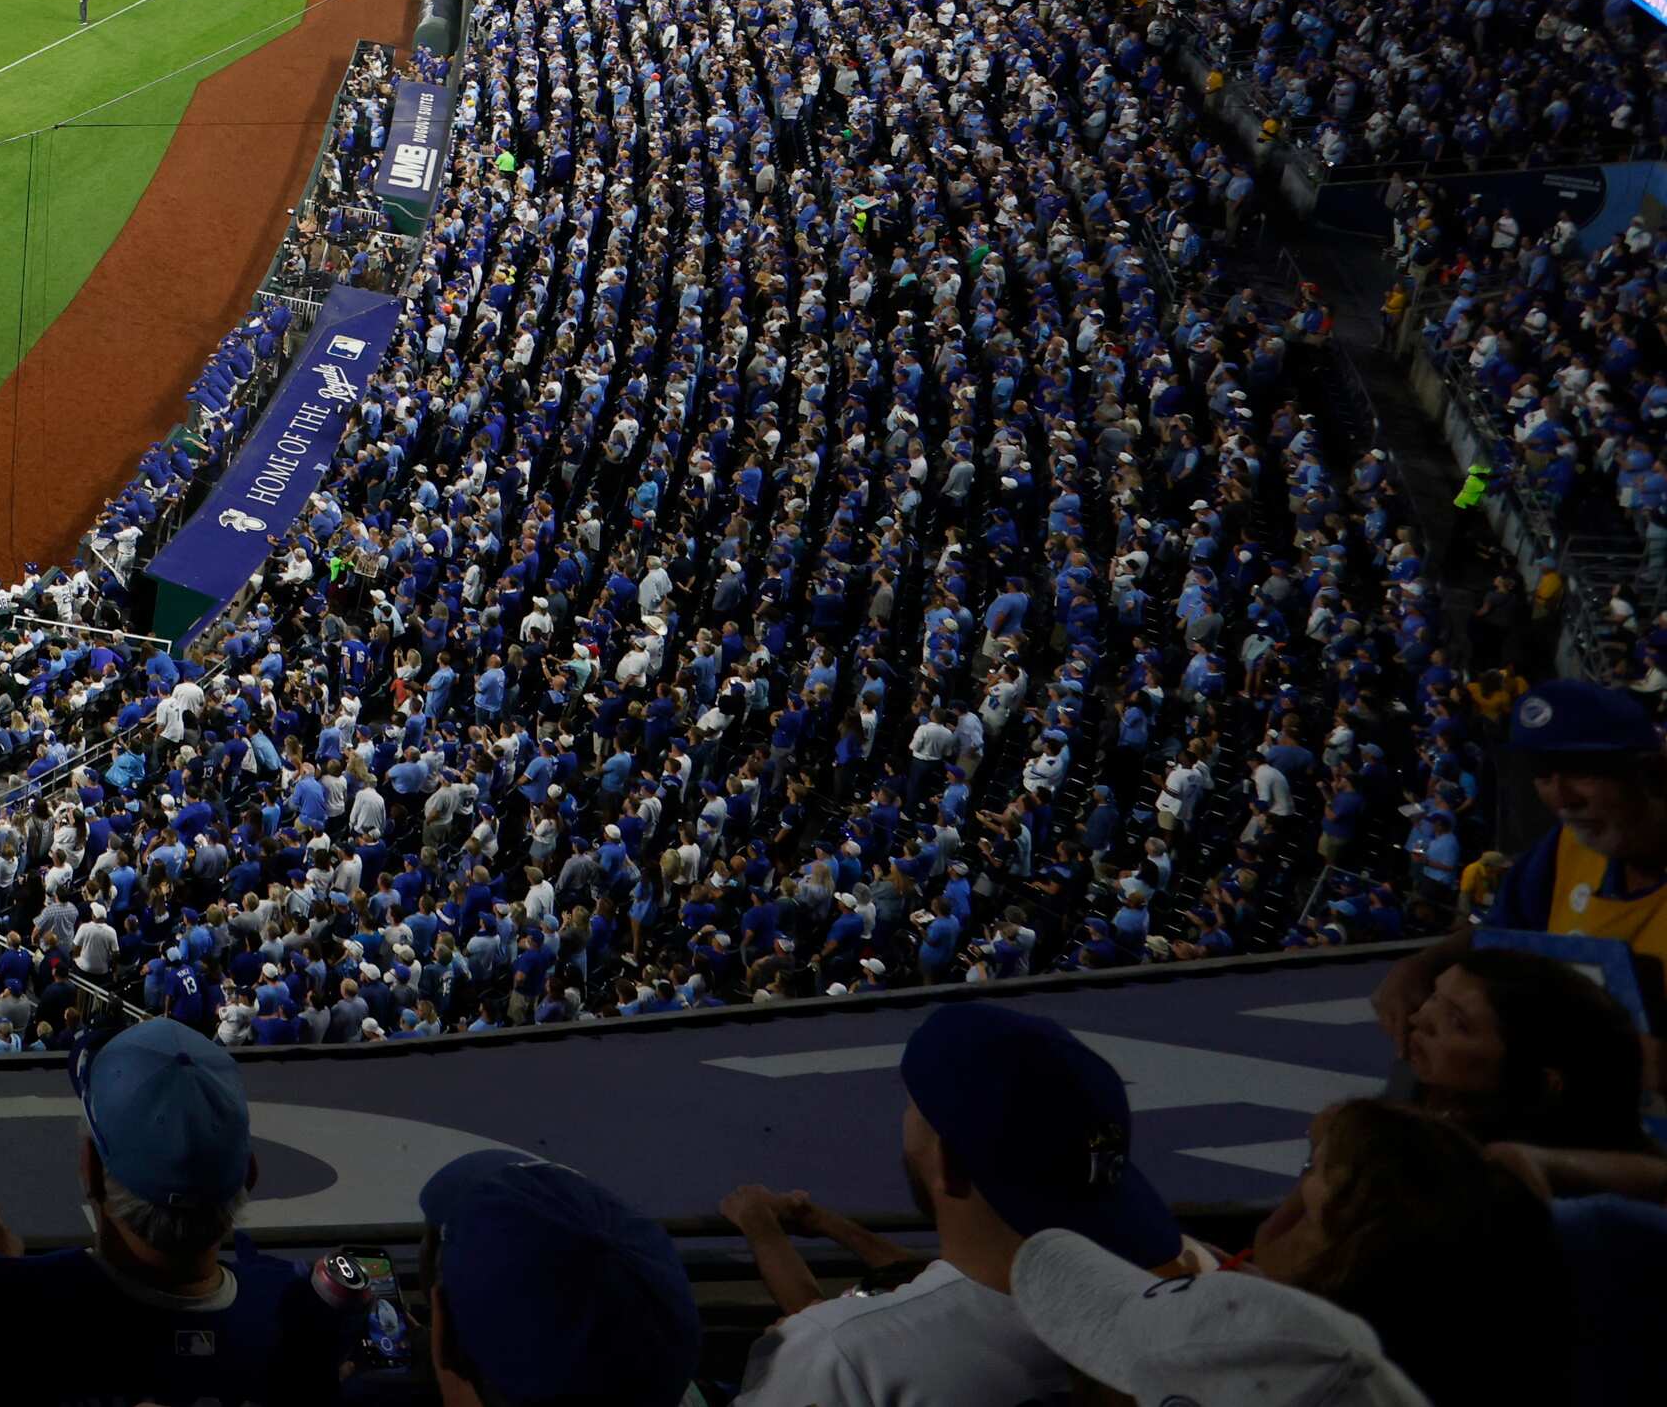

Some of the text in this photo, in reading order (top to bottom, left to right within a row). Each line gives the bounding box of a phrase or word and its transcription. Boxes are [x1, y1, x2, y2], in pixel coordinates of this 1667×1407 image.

[413, 93, 435, 144] DUGOUT SUITES
[388, 144, 429, 188] UMB
[246, 362, 360, 506] HOME OF THE Royals
[183, 976, 197, 994] 13
